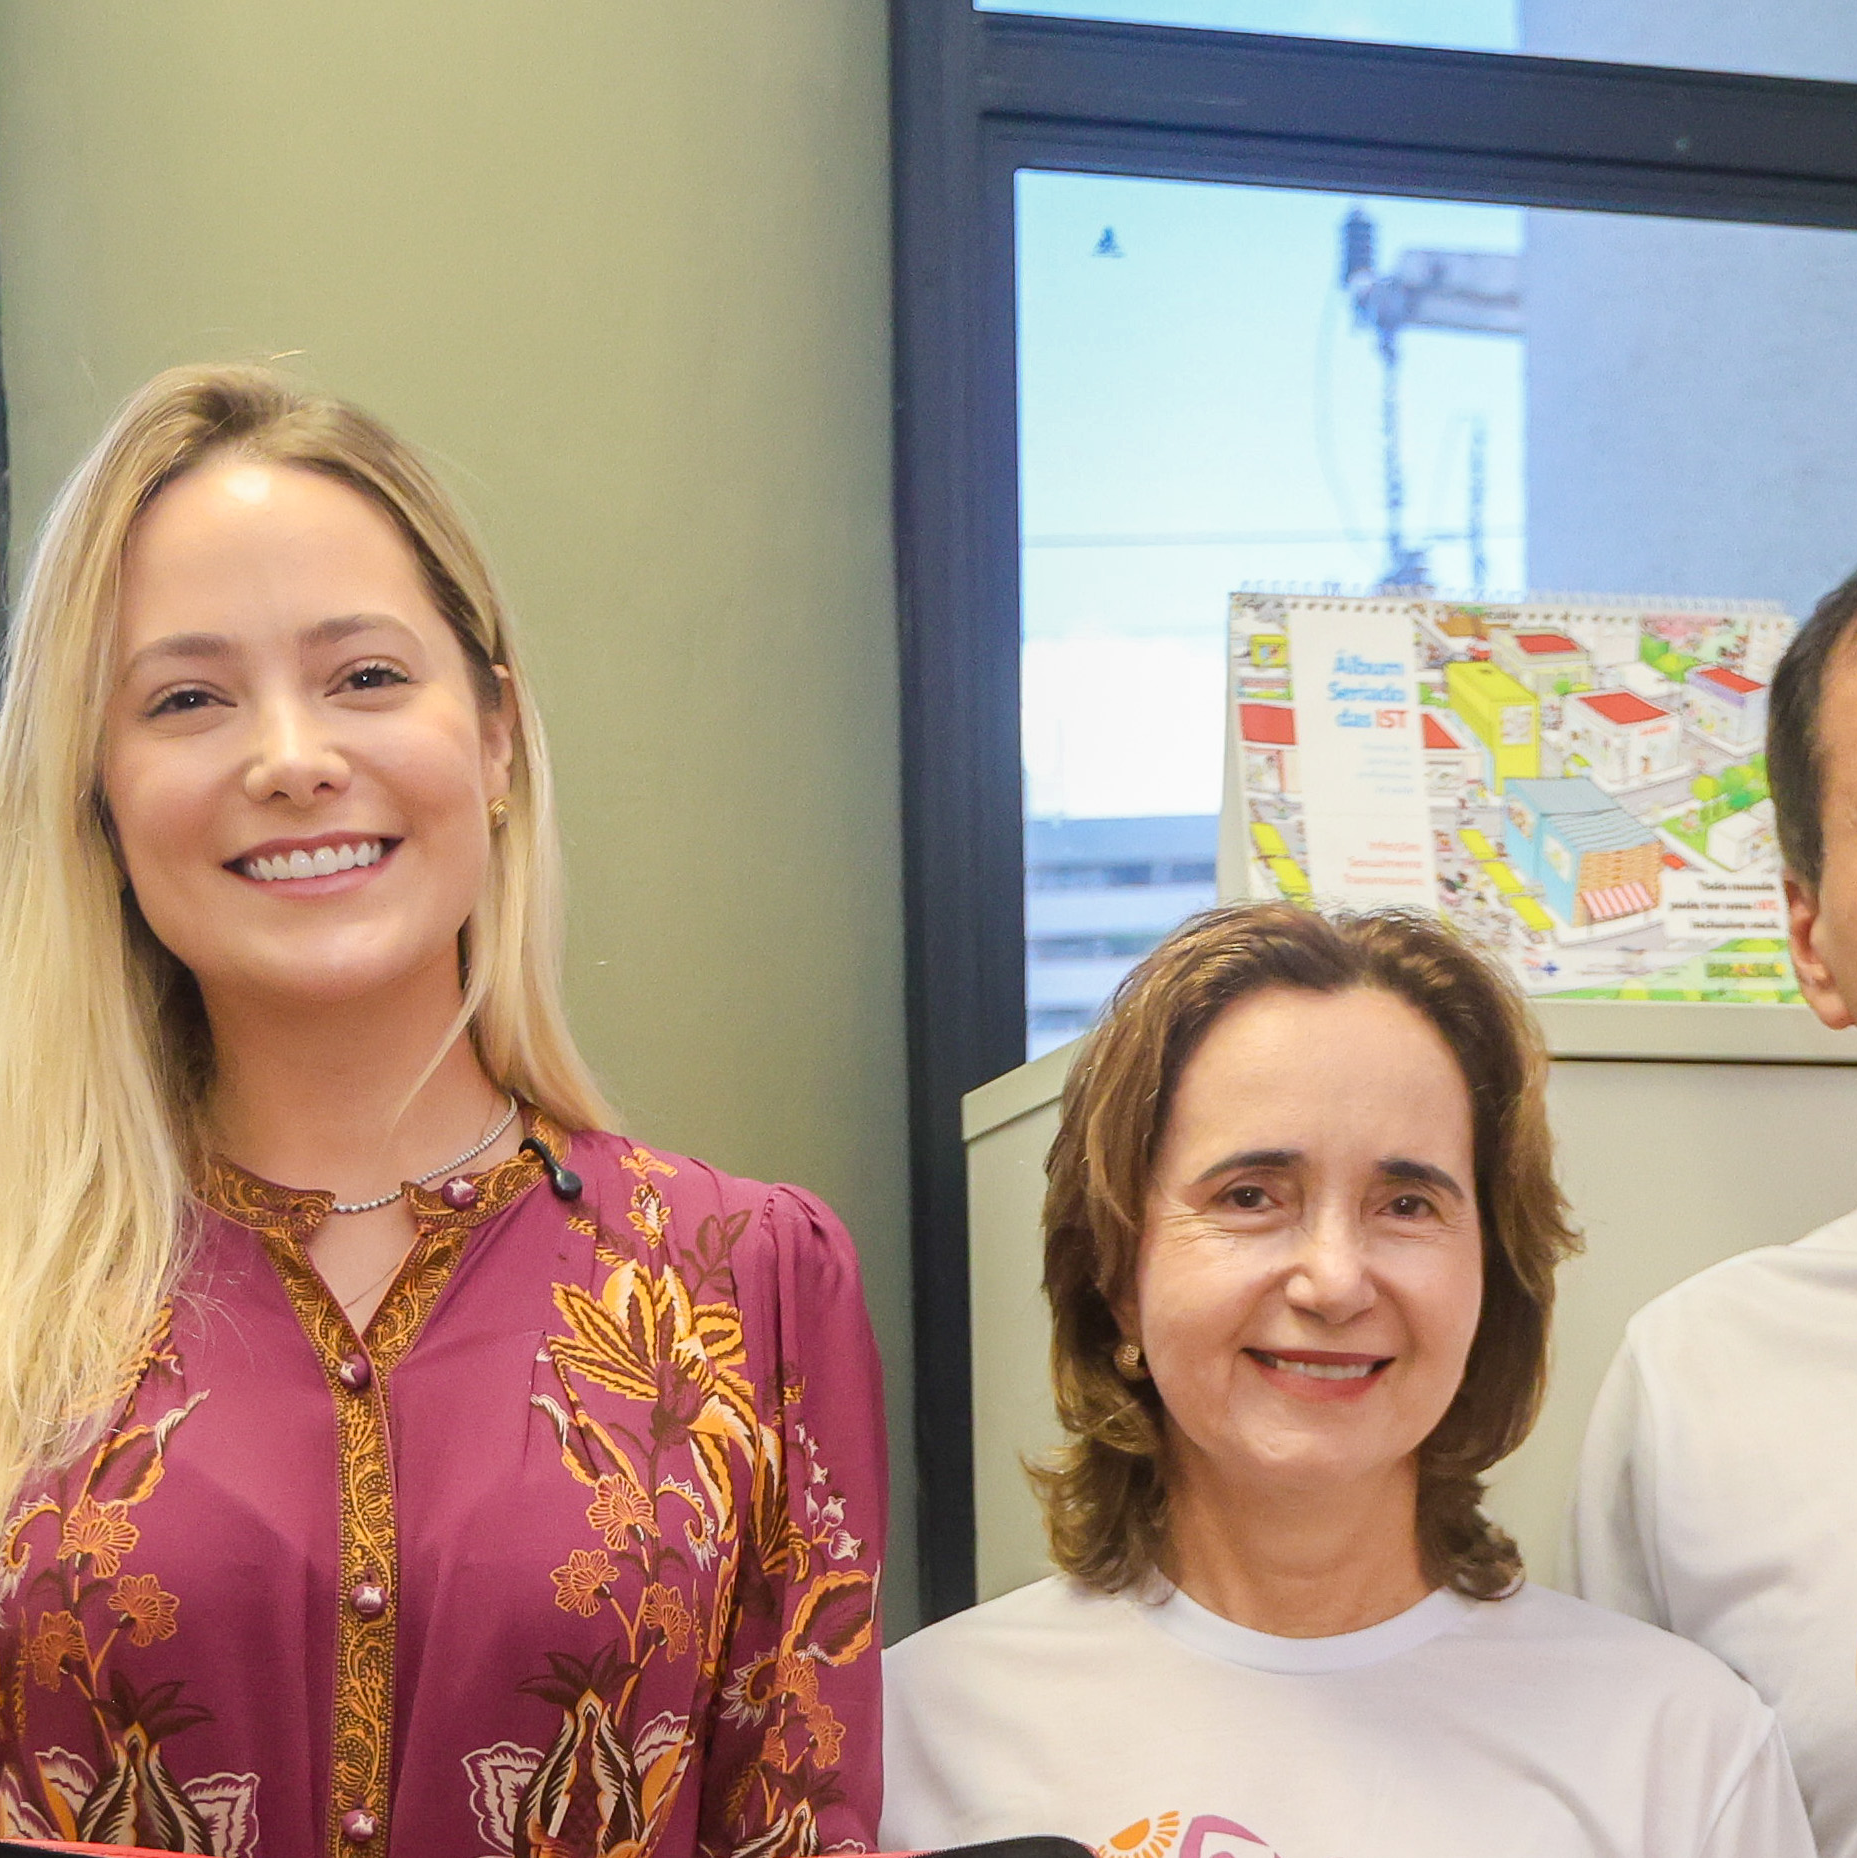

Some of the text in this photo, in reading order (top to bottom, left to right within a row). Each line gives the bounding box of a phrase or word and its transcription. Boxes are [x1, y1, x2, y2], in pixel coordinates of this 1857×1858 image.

[1333, 649, 1404, 675] Álbum
[1328, 681, 1406, 702] Seriado
[1335, 708, 1408, 728] das IST
